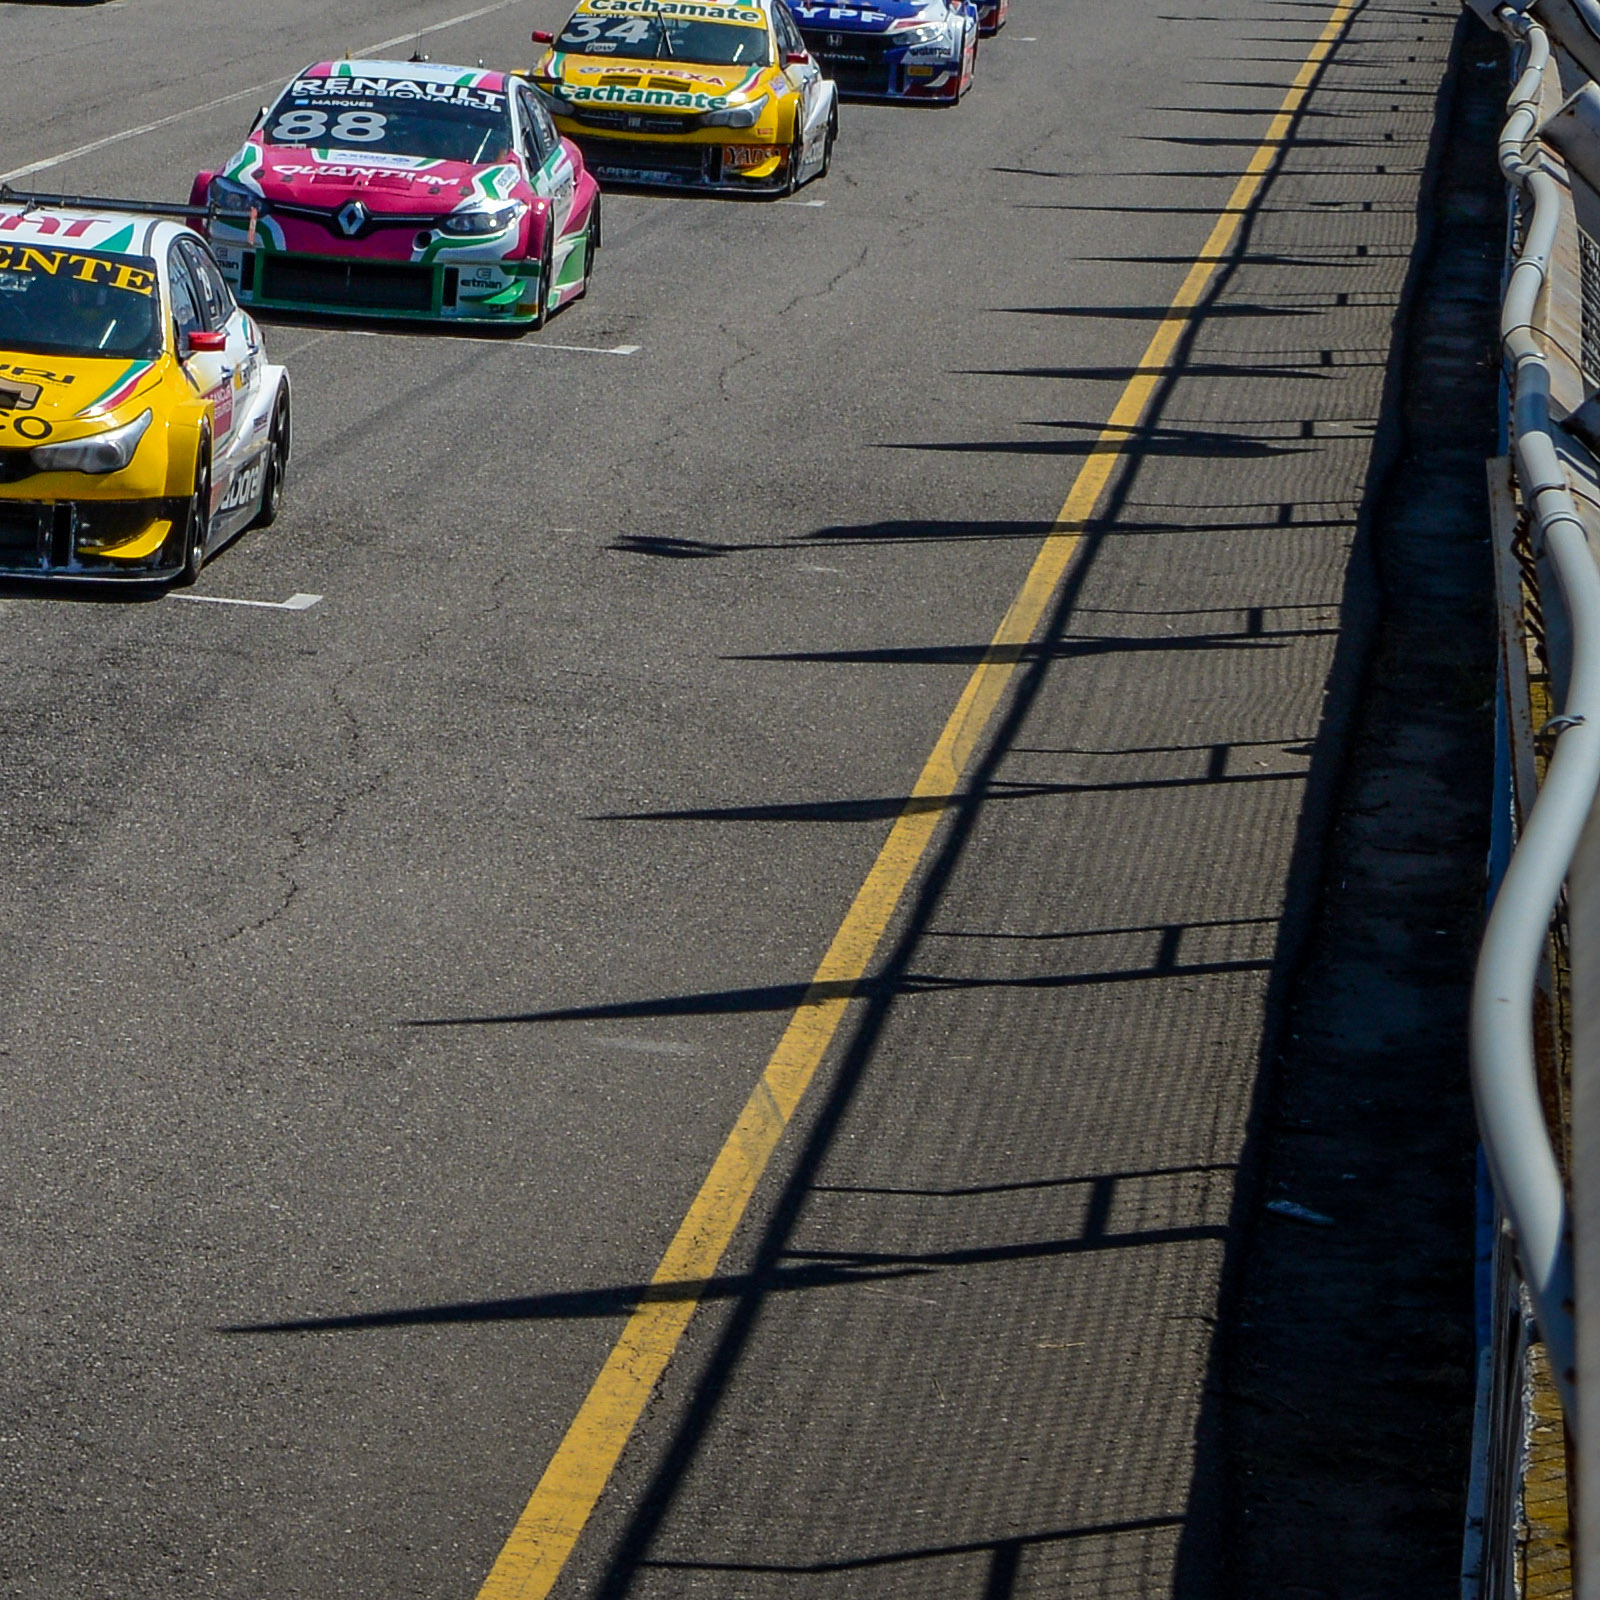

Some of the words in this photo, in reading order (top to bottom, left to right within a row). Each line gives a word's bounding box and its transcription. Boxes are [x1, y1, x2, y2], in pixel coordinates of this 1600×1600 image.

[794, 6, 887, 23] YPF
[561, 17, 652, 44] 34
[605, 66, 727, 86] MADEXA
[291, 78, 506, 105] RENAULT
[311, 99, 374, 107] MARQUES
[553, 84, 730, 111] Cachamate
[272, 110, 388, 142] 88
[272, 164, 460, 186] QUANTIUM
